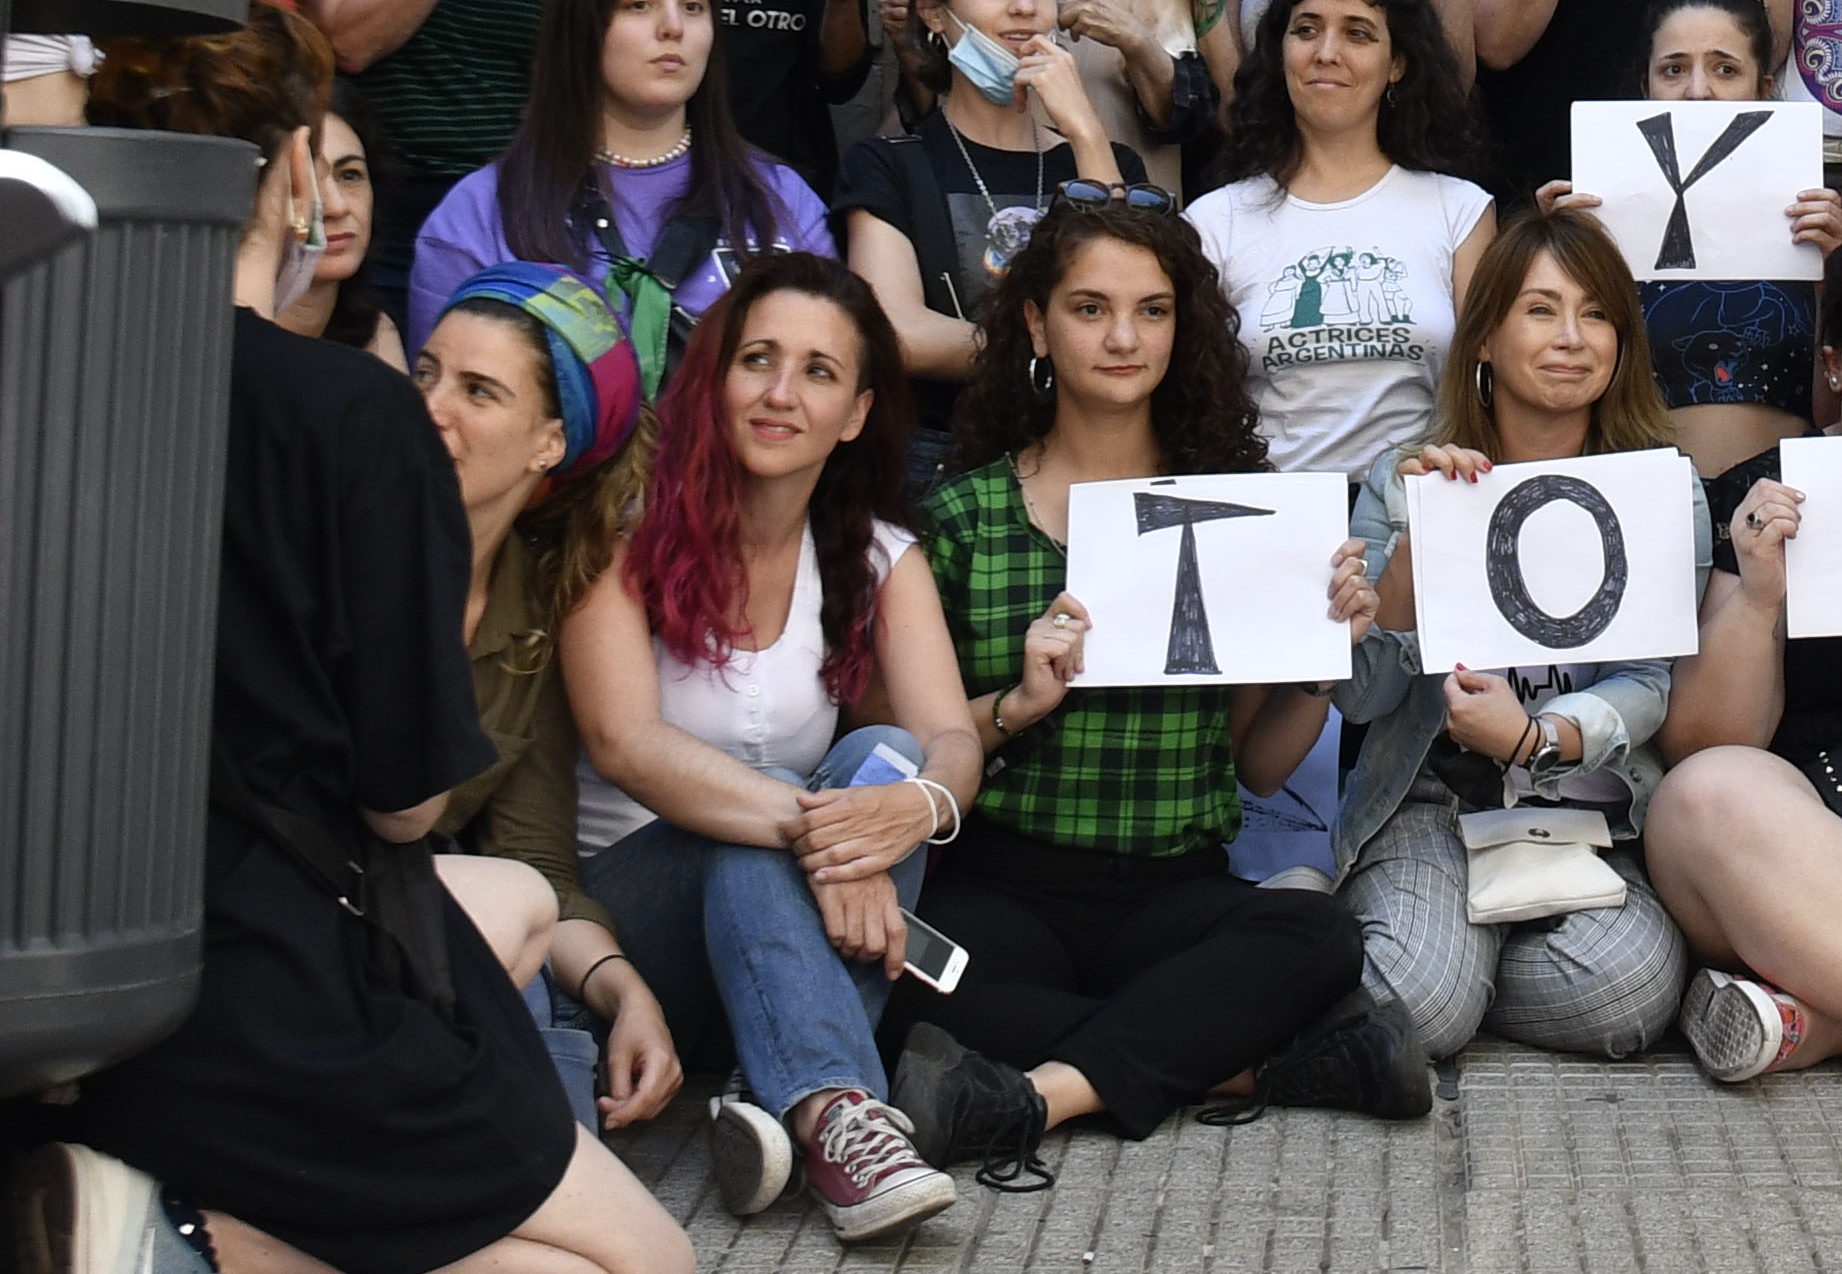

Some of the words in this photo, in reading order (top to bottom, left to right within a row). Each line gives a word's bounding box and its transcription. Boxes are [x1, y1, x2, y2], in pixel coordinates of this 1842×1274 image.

[747, 10, 807, 31] OTRO
[1636, 110, 1774, 270] Y
[1267, 327, 1411, 354] ACTRICES
[1262, 343, 1424, 371] ARGENTINAS
